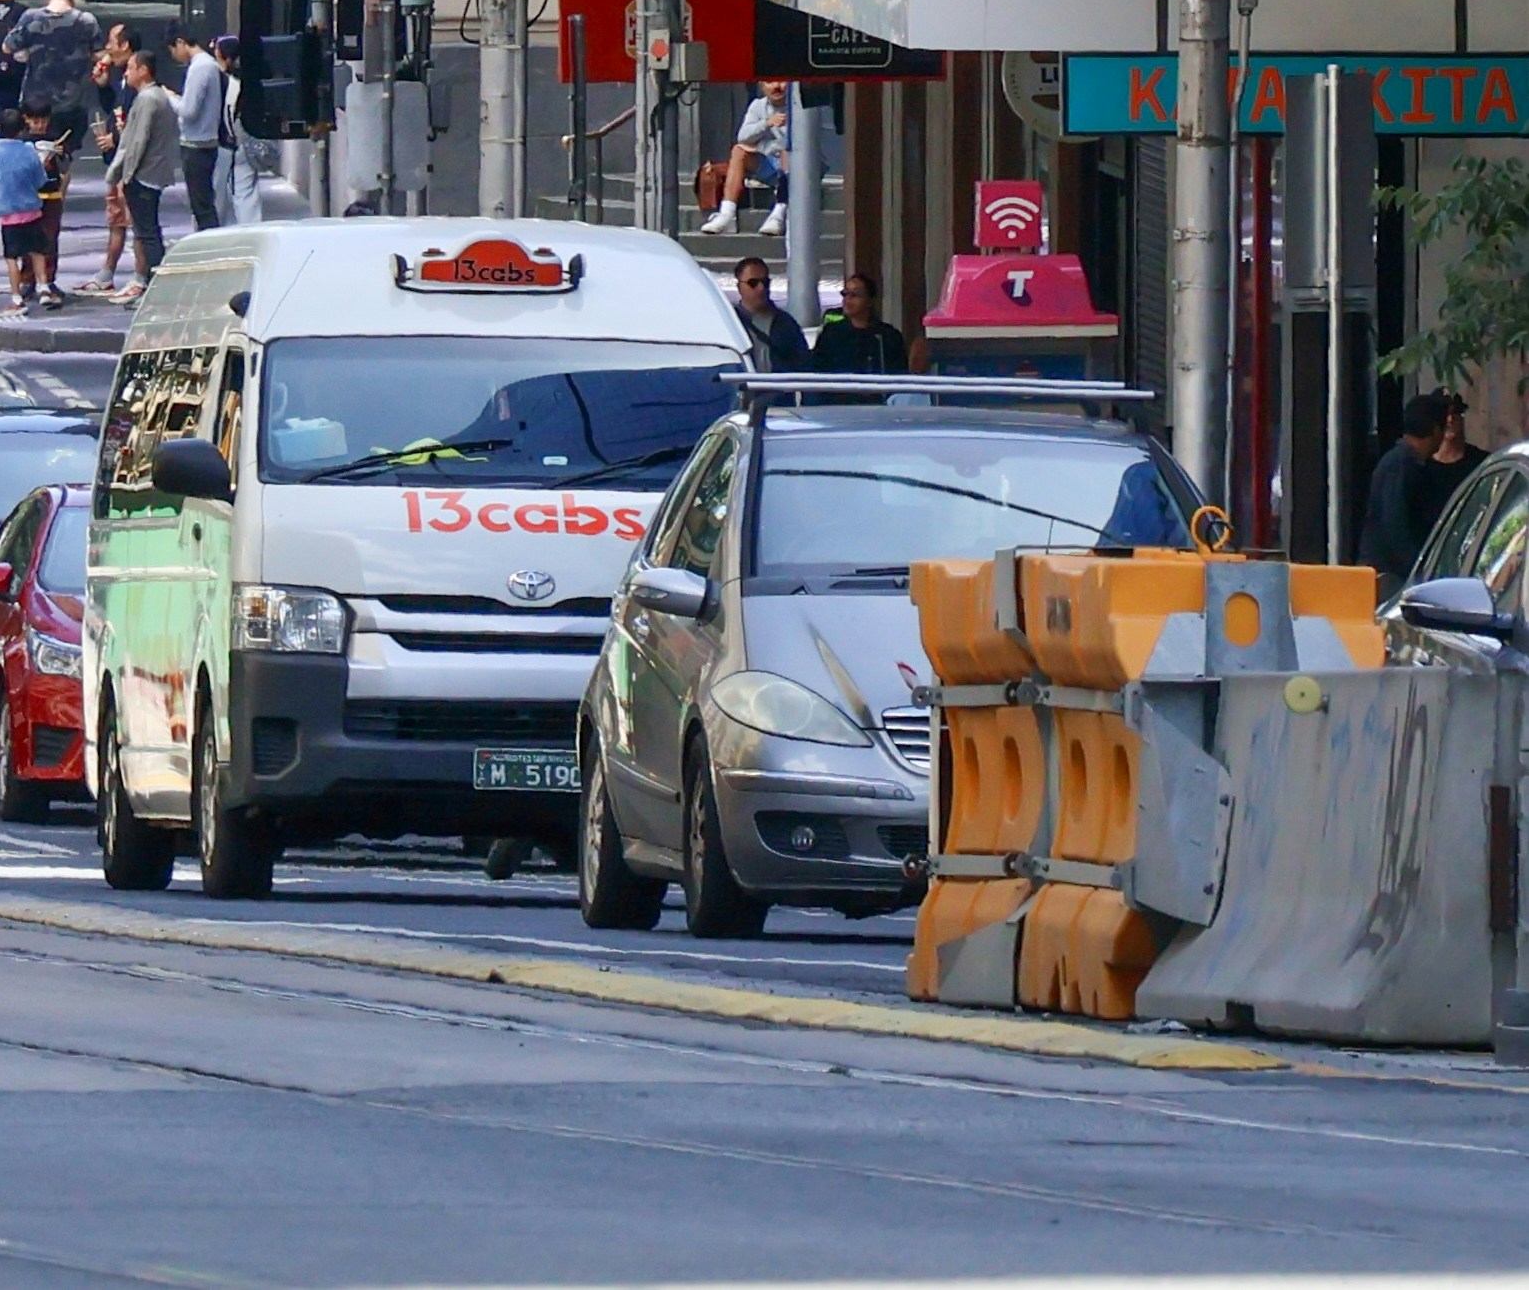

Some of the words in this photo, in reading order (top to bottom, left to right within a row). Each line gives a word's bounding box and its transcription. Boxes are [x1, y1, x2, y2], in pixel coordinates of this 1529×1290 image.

[1129, 68, 1286, 123] KA
[453, 259, 536, 283] 13cabs
[401, 491, 647, 541] 13cabs
